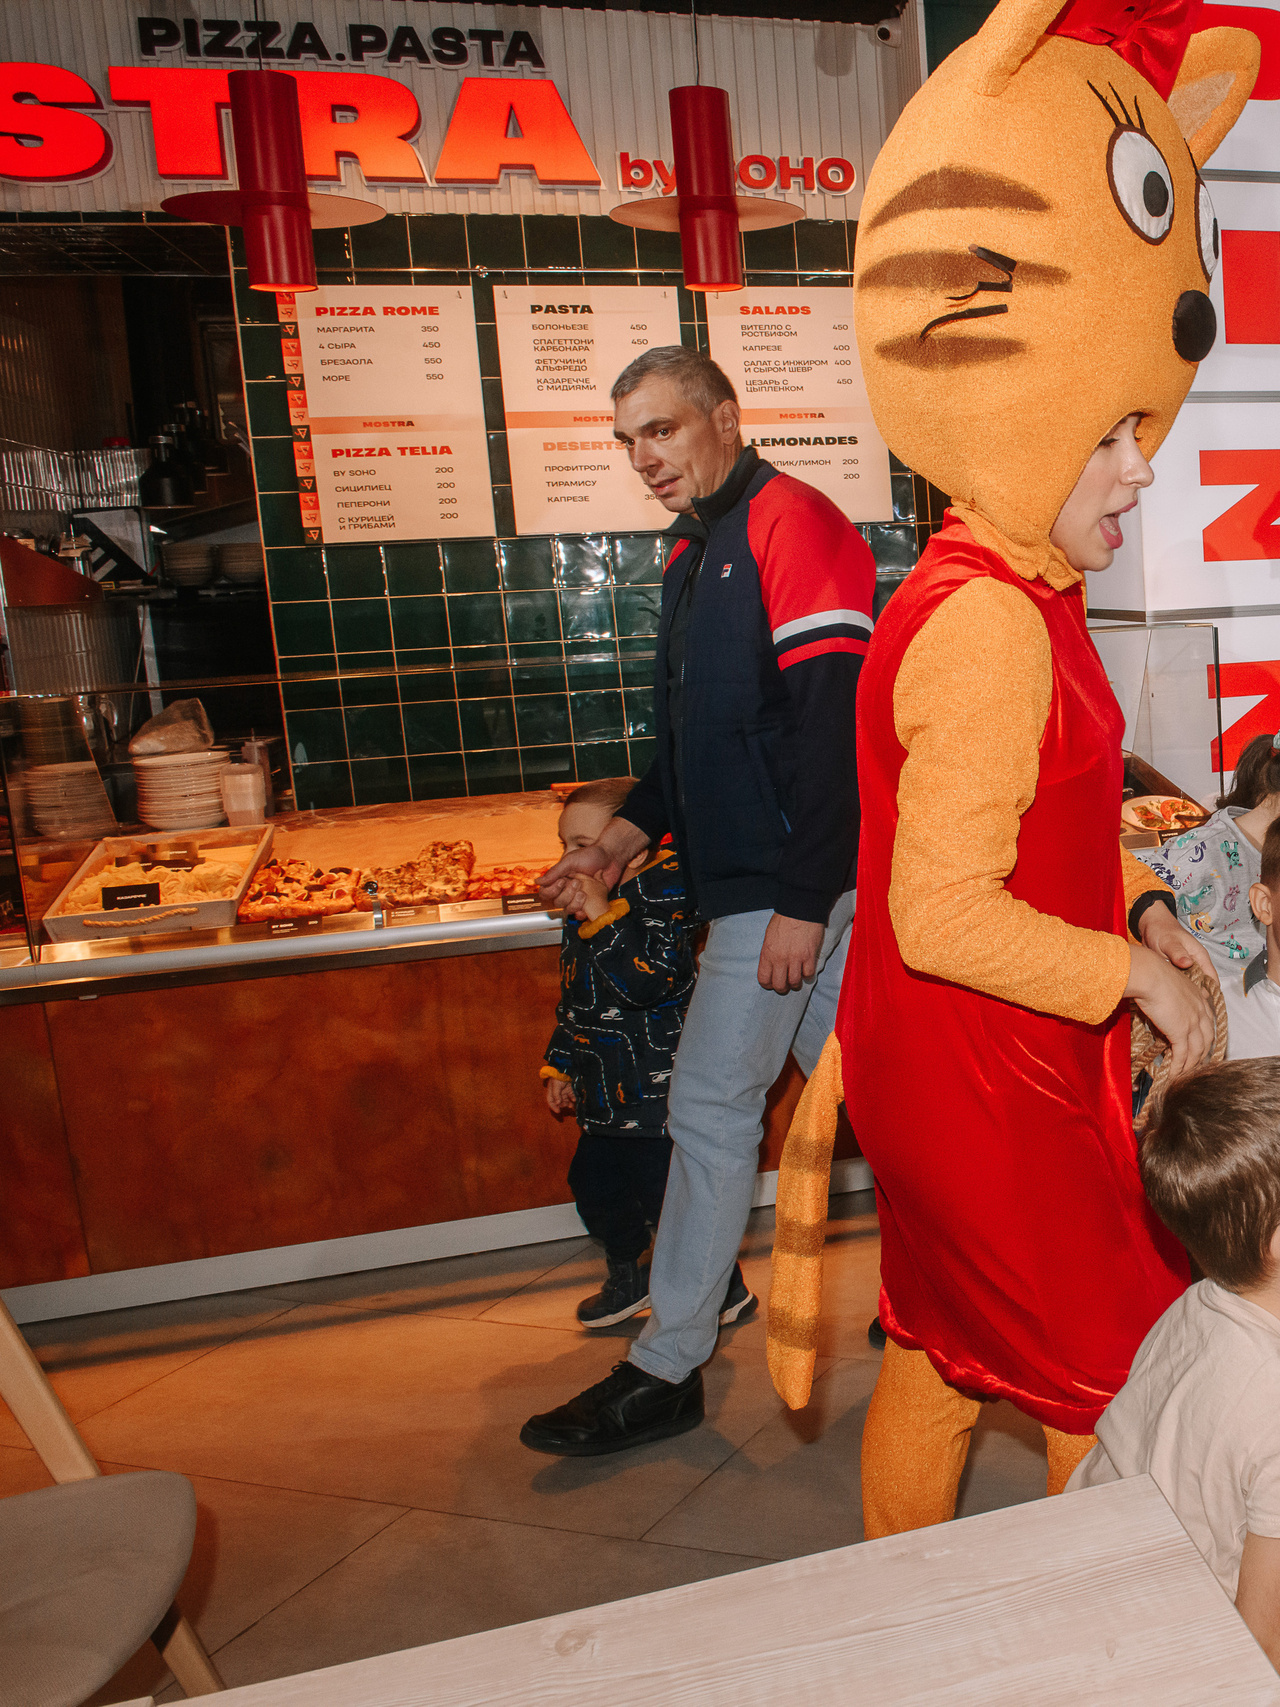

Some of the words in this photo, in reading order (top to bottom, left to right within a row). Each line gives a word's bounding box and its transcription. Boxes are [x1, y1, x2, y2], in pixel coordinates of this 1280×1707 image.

[138, 17, 547, 69] PIZZA.PASTA
[733, 154, 856, 192] OHO
[315, 306, 376, 317] PIZZA
[382, 306, 440, 316] ROME
[530, 304, 594, 315] PASTA
[739, 305, 812, 316] SALADS
[316, 325, 376, 334] МАРГАРИТА
[421, 325, 440, 333] 350
[531, 323, 589, 331] БОЛОНЬЕЗЕ
[327, 342, 357, 350] СЫРА
[422, 341, 441, 349] 450
[532, 338, 595, 346] СПАГЕТТОНИ
[631, 338, 649, 346] 450
[533, 345, 591, 353] КАРБОНАРА
[320, 358, 374, 366] БРЕЗАОЛА
[424, 357, 443, 365] 550
[322, 374, 351, 382] МОРЕ
[425, 373, 444, 381] 550
[536, 377, 591, 385] КАЗАРЕЧЧЕ
[745, 379, 780, 387] ЦЕЗАРЬ
[546, 384, 597, 392] МИДИЯМИ
[362, 420, 415, 428] MOSTRA
[750, 436, 859, 447] LEMONADES
[543, 441, 627, 452] DESERTS
[331, 447, 392, 458] PIZZA
[397, 445, 453, 457] TELIA
[771, 459, 832, 467] ИЛИК/ЛИМОН
[842, 458, 859, 466] 200
[435, 466, 454, 474] 200
[544, 464, 610, 472] ПРОФИТРОЛИ
[335, 484, 393, 493] СИЦИЛИЕЦ
[436, 481, 456, 489] 200
[546, 480, 597, 488] ТИРАМИСУ
[336, 500, 391, 508] ПЕПЕРОНИ
[438, 497, 458, 505] 200
[547, 495, 590, 503] КАПРЕЗЕ
[338, 516, 346, 524] С
[347, 513, 395, 523] КУРИЦЕЙ
[440, 512, 459, 520] 200
[348, 522, 396, 530] ГРИБАМИ
